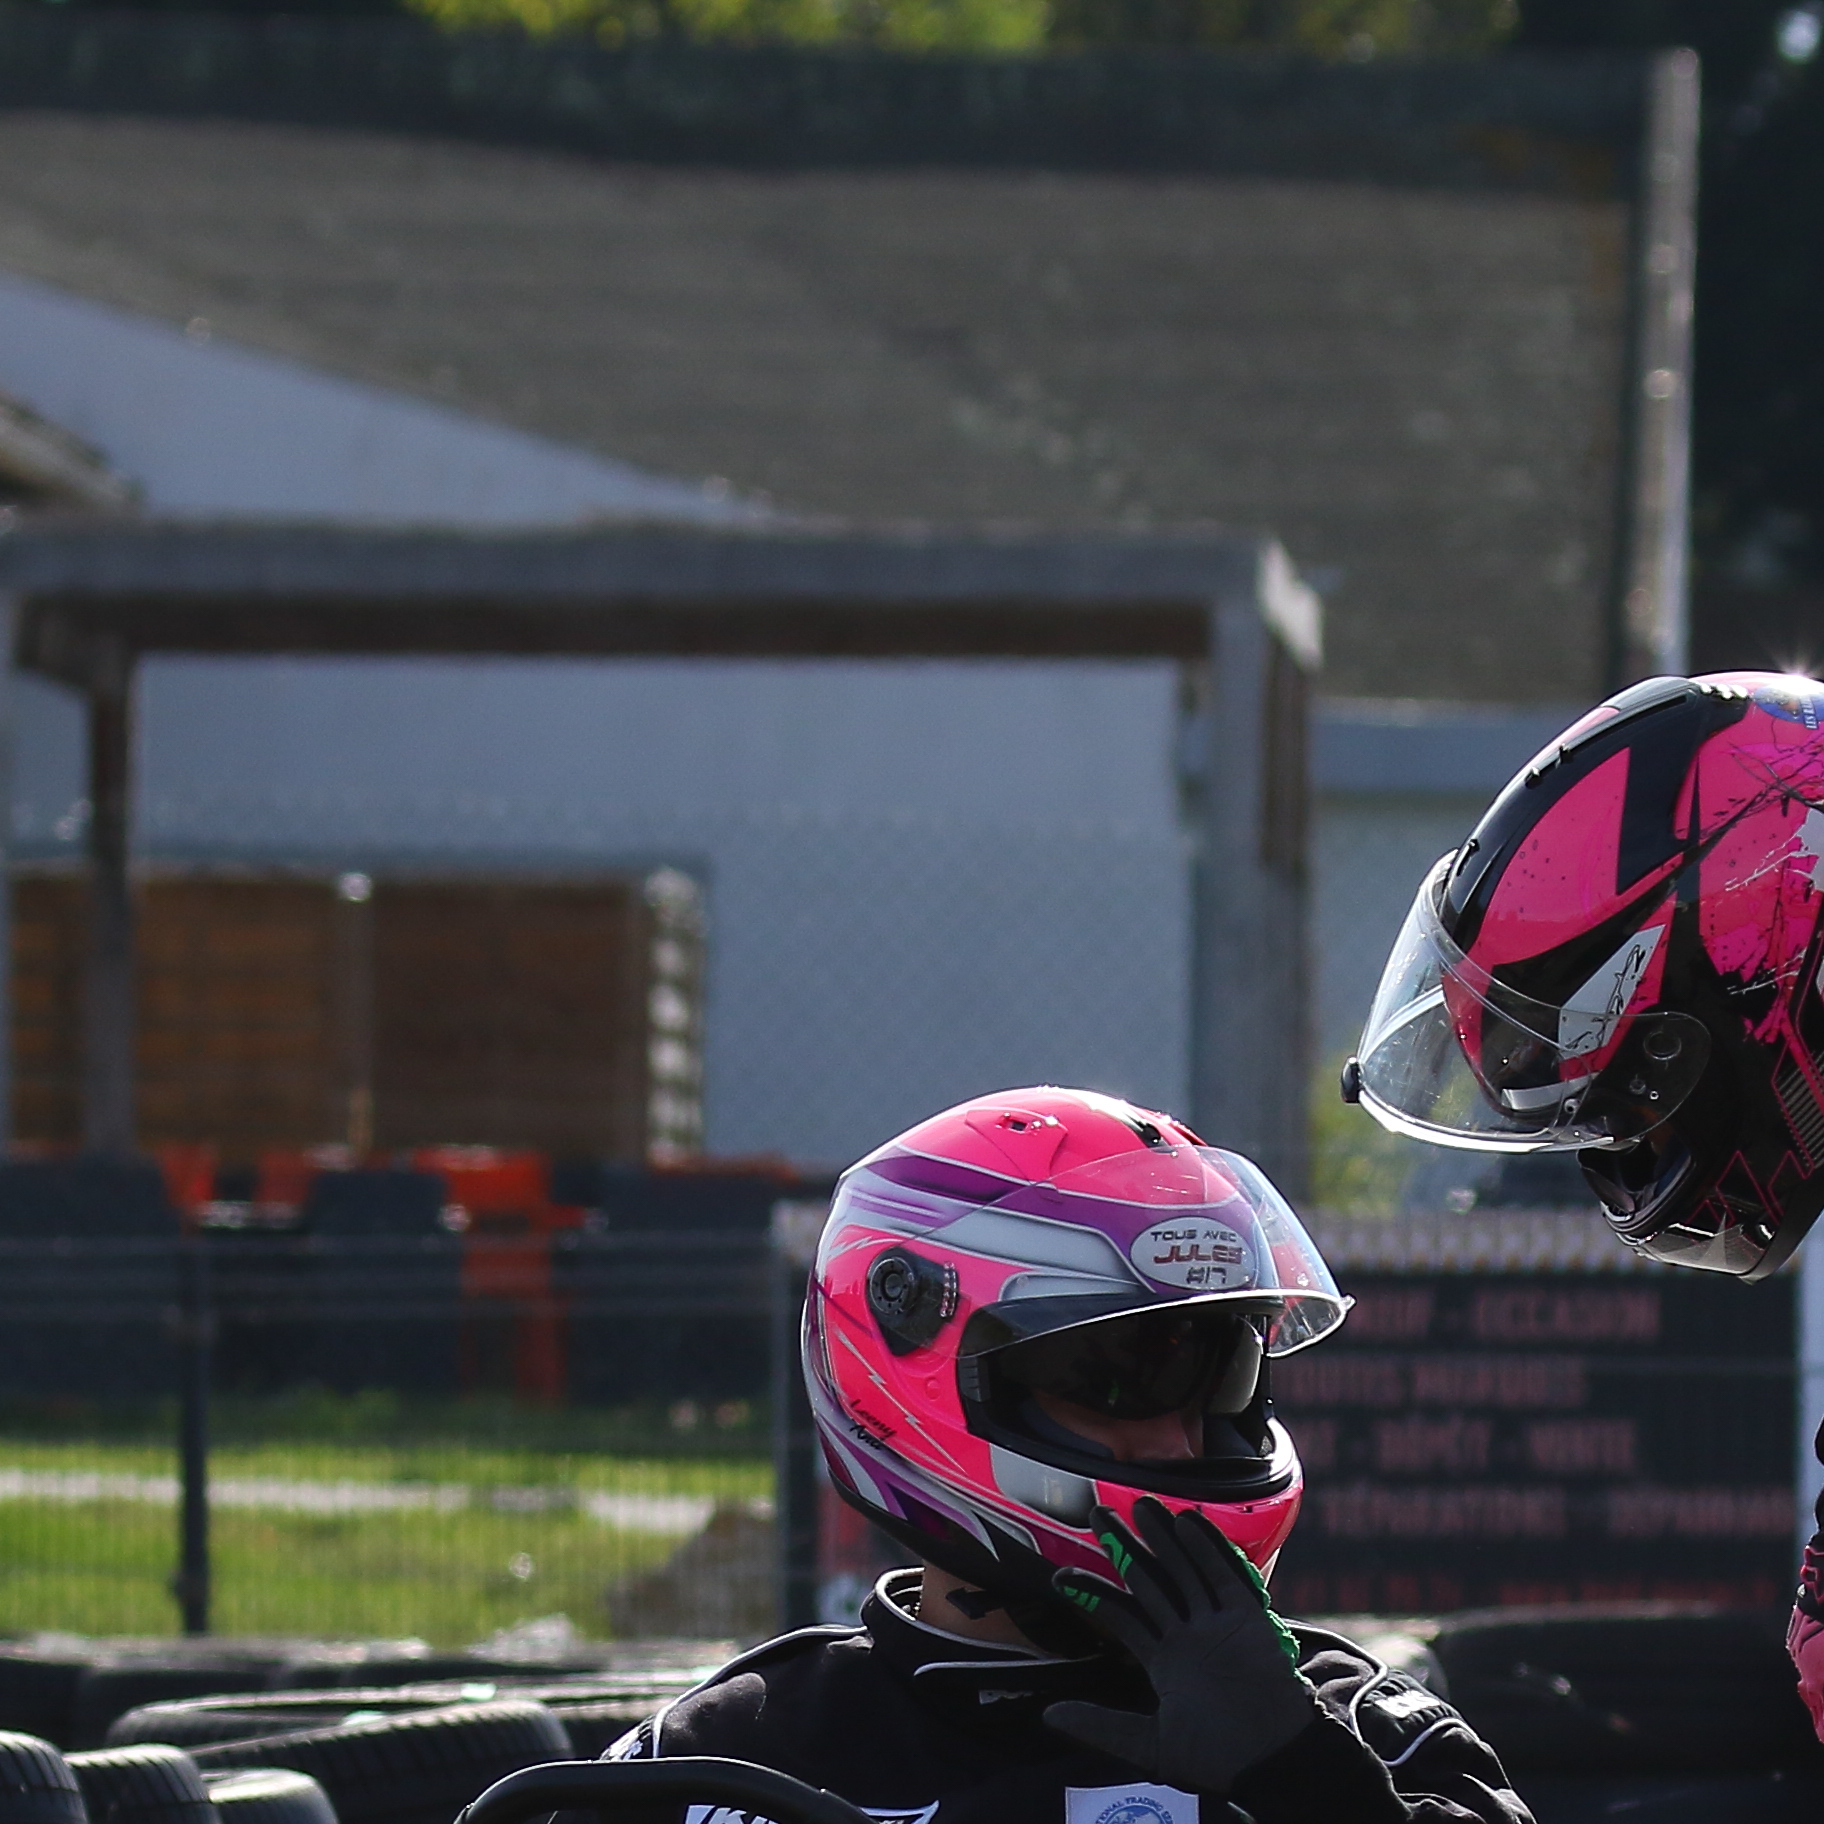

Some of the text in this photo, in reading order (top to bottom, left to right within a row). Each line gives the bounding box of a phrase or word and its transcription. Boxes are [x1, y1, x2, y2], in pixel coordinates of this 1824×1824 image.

[1150, 1229, 1237, 1242] TOUS AVEC
[1153, 1244, 1242, 1264] JULES
[1125, 1797, 1163, 1812] TRADING
